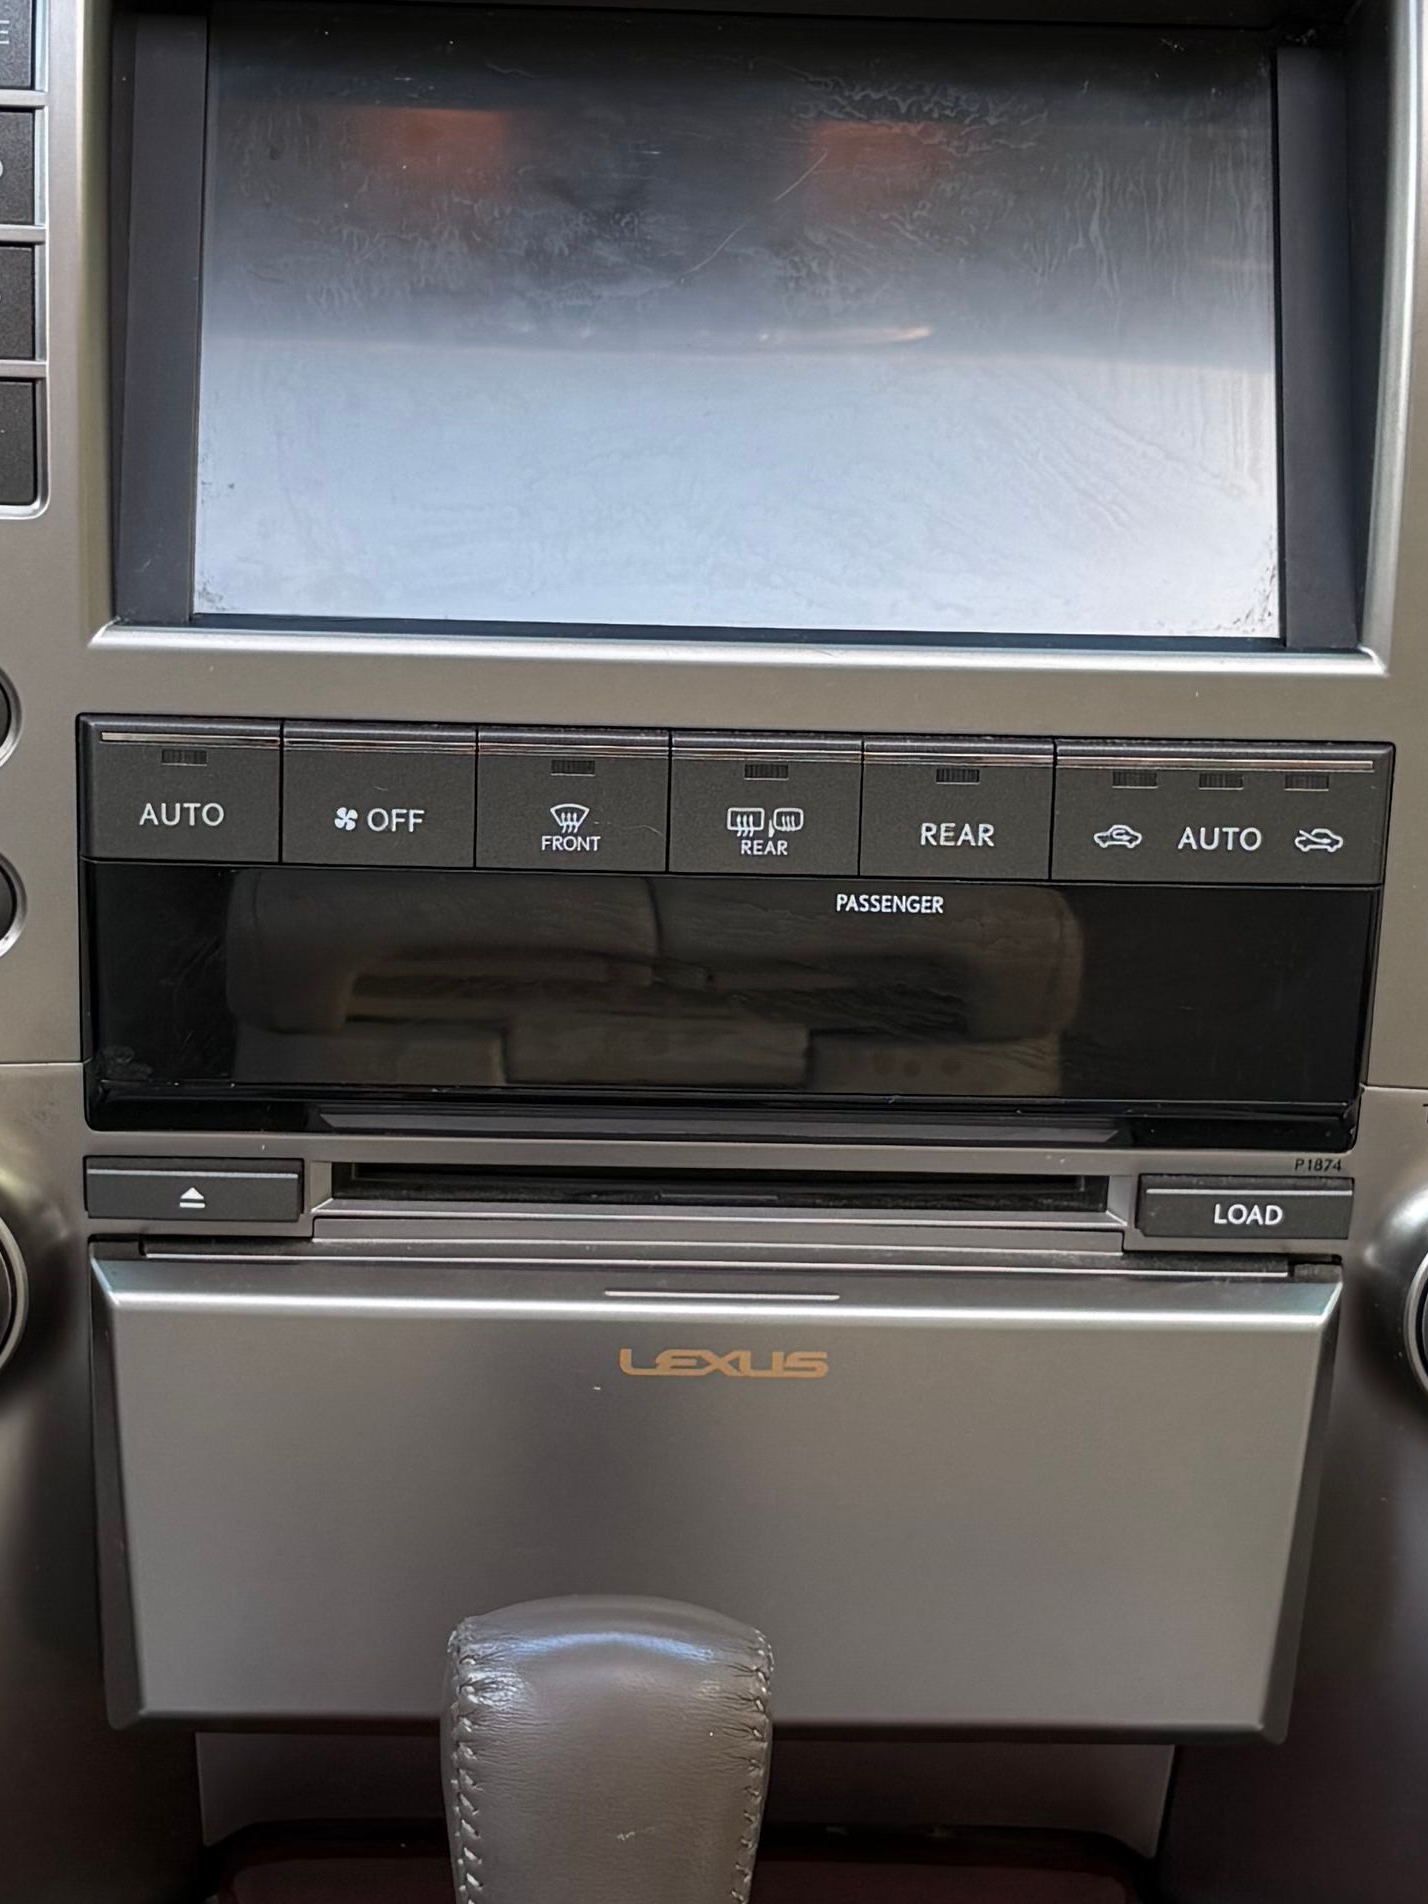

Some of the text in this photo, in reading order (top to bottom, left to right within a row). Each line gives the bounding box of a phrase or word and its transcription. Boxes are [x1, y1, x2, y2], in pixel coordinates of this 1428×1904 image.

[139, 802, 225, 827] AUTO
[367, 807, 425, 833] OFF
[541, 835, 601, 852] FRONT
[920, 822, 995, 847] REAR
[1177, 826, 1262, 851] AUTO
[740, 839, 788, 856] REAR
[836, 893, 944, 914] PASSENGER
[1294, 1158, 1342, 1172] P1874
[1214, 1203, 1283, 1226] LOAD
[618, 1348, 829, 1380] LEXUS
